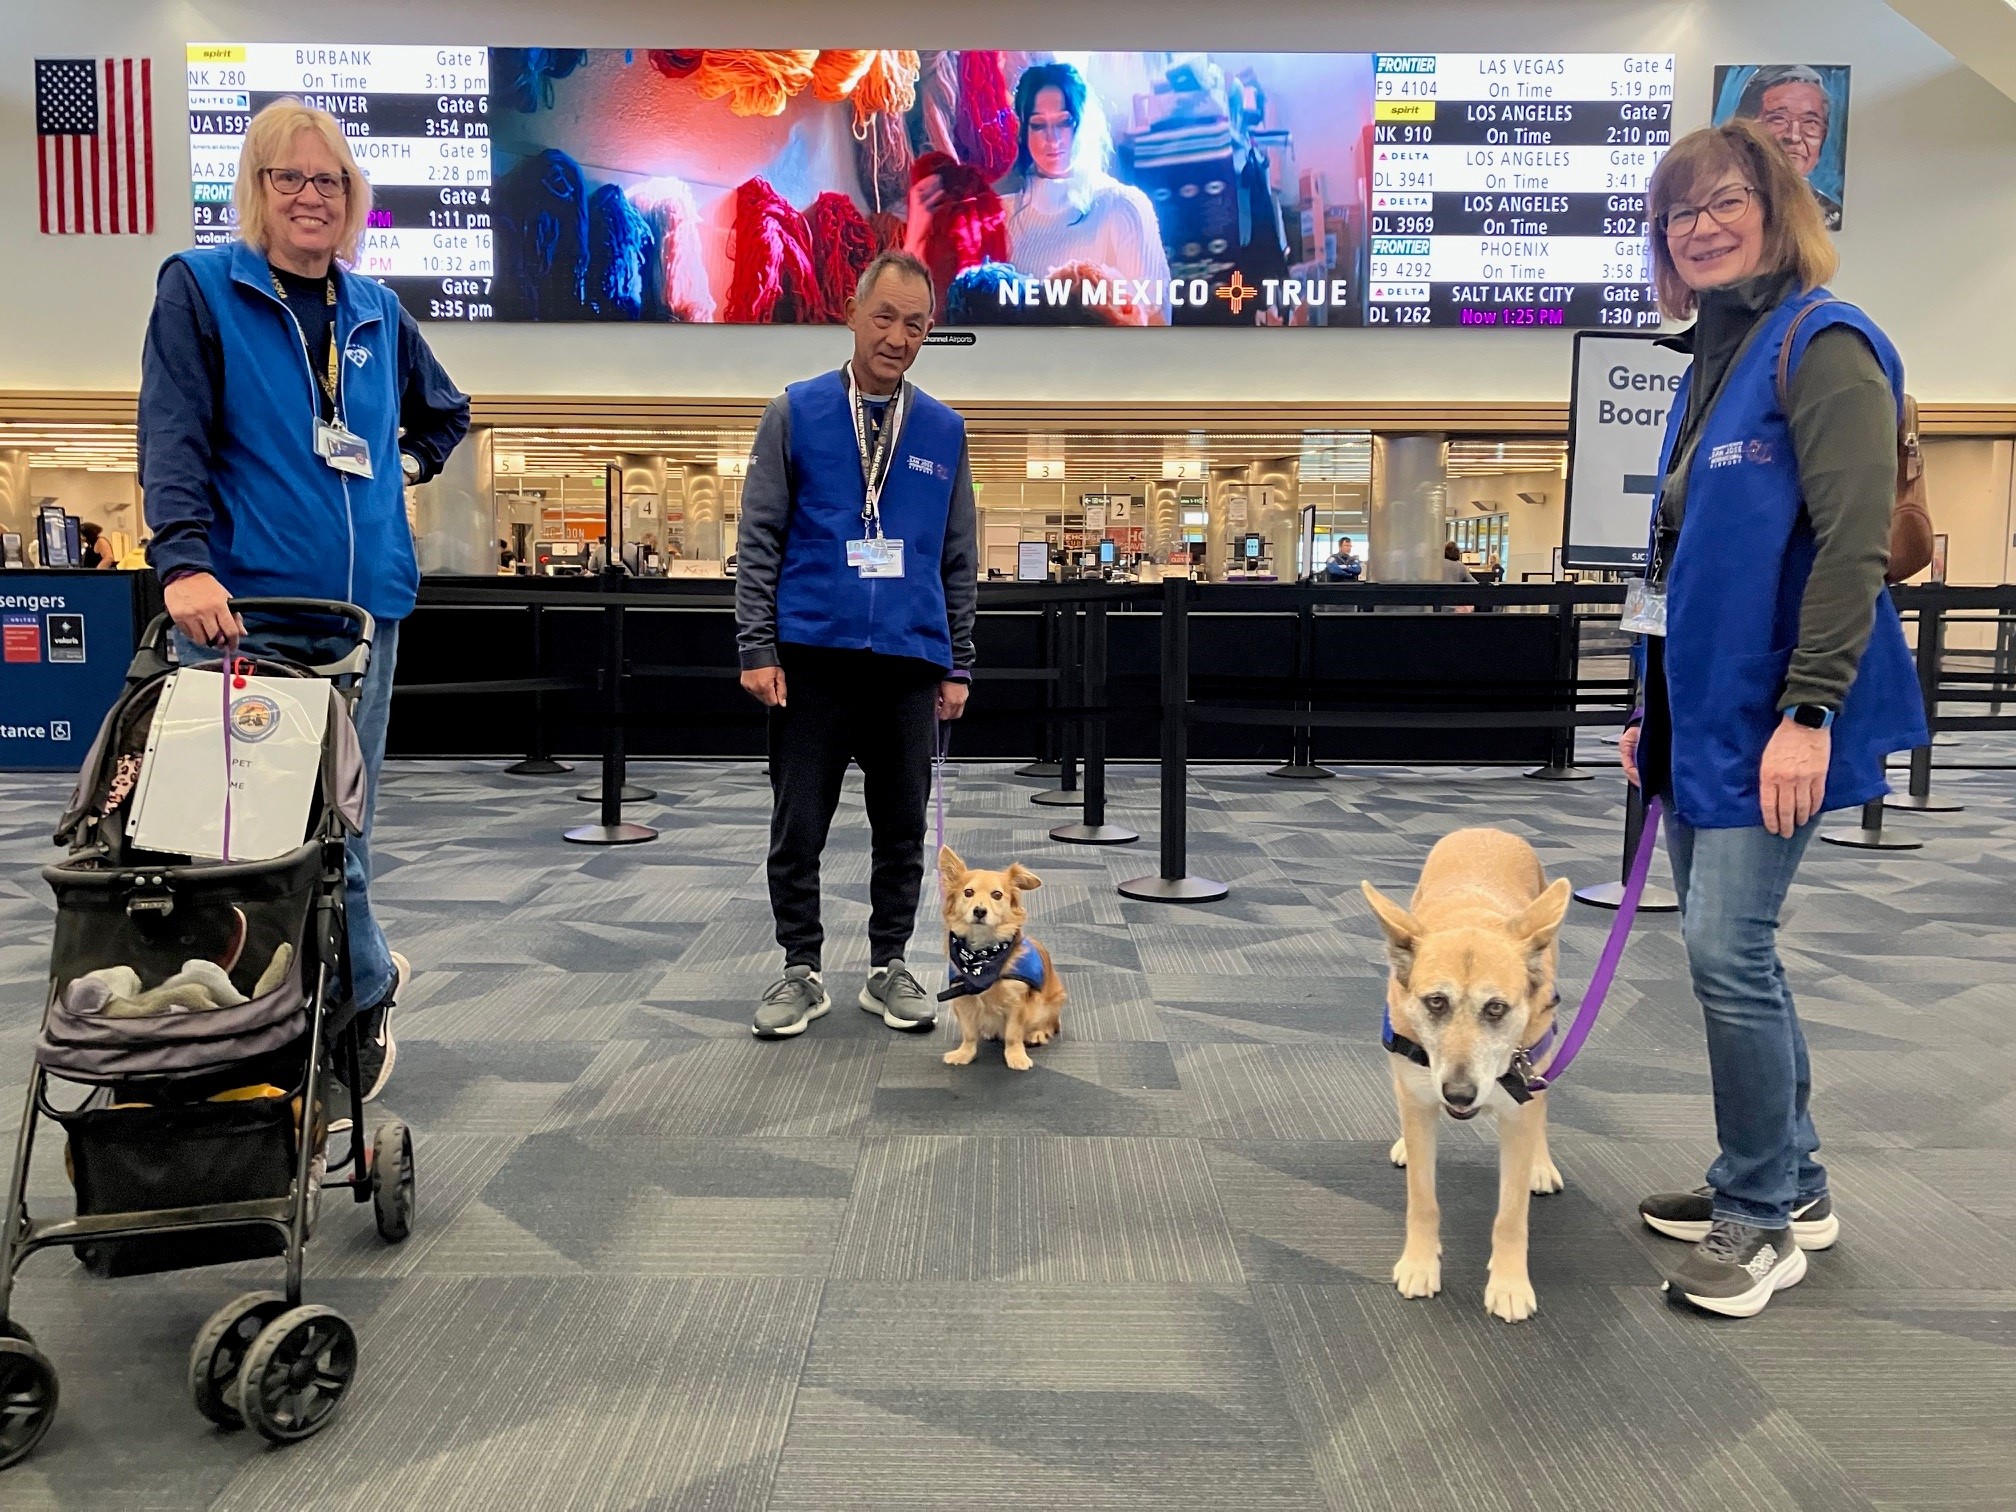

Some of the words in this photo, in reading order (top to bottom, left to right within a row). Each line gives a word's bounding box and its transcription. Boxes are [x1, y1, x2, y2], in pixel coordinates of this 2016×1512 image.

[203, 49, 231, 59] spirit
[296, 49, 371, 65] BURBANK
[437, 51, 471, 66] Gate
[478, 51, 485, 65] 7
[1377, 57, 1435, 72] FRONTIER
[1480, 60, 1506, 74] LAS
[1513, 59, 1564, 74] VEGAS
[1624, 58, 1659, 73] Gate
[1665, 58, 1673, 72] 4
[189, 71, 209, 85] NK
[220, 71, 246, 85] 280
[303, 73, 323, 88] On
[331, 73, 366, 89] Time
[425, 74, 456, 89] 3:13
[464, 77, 486, 92] pm
[1377, 81, 1392, 95] F9
[1401, 81, 1437, 95] 4104
[1489, 83, 1509, 97] On
[1517, 82, 1553, 97] Time
[1610, 81, 1642, 96] 5:19
[1649, 84, 1671, 99] pm
[304, 95, 368, 113] DENVER
[437, 96, 474, 113] Gate
[478, 96, 488, 113] 6
[1391, 106, 1419, 115] spirit
[1620, 103, 1657, 120] Gate
[1662, 103, 1671, 120] 7
[1467, 105, 1496, 121] LOS
[1501, 105, 1573, 121] ANGELES
[337, 118, 370, 136] ime
[425, 119, 459, 136] 3:54
[464, 121, 488, 139] pm
[1375, 126, 1397, 142] NK
[1404, 126, 1432, 142] 910
[1487, 128, 1508, 144] On
[1514, 127, 1551, 144] Time
[1606, 126, 1640, 143] 2:10
[1646, 130, 1670, 146] pm
[353, 144, 411, 158] WORTH
[440, 143, 474, 158] Gate
[481, 144, 488, 158] 9
[1610, 150, 1645, 165] Gate
[1467, 151, 1494, 166] LOS
[1501, 151, 1570, 166] ANGELES
[428, 166, 459, 180] 2:28
[467, 169, 489, 184] pm
[1375, 172, 1392, 187] DL
[1399, 172, 1433, 187] 3941
[1486, 174, 1505, 188] On
[1514, 174, 1548, 188] Time
[1606, 173, 1636, 188] 3:41
[194, 184, 233, 200] FRONT
[440, 188, 476, 205] Gate
[480, 188, 490, 205] 4
[1464, 196, 1493, 212] LOS
[1498, 196, 1569, 212] ANGELES
[1607, 195, 1644, 212] Gate
[194, 207, 211, 224] F9
[368, 211, 391, 227] PM
[429, 211, 460, 227] 1:11
[467, 213, 490, 229] pm
[1372, 217, 1392, 233] DL
[1397, 217, 1434, 233] 3969
[1483, 219, 1505, 234] On
[1511, 218, 1547, 234] Time
[1603, 218, 1635, 234] 5:02
[1641, 221, 1650, 237] p
[433, 234, 468, 249] Gate
[475, 235, 490, 249] 16
[1372, 240, 1429, 254] FRONTIER
[1481, 242, 1549, 256] PHOENIX
[1615, 242, 1650, 256] Gate
[370, 257, 392, 271] PM
[423, 257, 462, 271] 10:32
[469, 261, 491, 271] am
[1372, 262, 1387, 277] F9
[1396, 262, 1431, 277] 4292
[1483, 264, 1502, 279] On
[1511, 264, 1545, 279] Time
[1602, 264, 1633, 279] 3:58
[442, 278, 479, 295] Gate
[482, 279, 492, 295] 7
[998, 279, 1072, 306] NEW
[1082, 279, 1209, 306] MEXICO
[1262, 279, 1348, 306] TRUE
[1387, 288, 1424, 296] DELTA
[1452, 286, 1490, 302] SALT
[1495, 286, 1534, 302] LAKE
[1540, 286, 1575, 302] CITY
[1603, 286, 1639, 301] Gate
[430, 300, 463, 317] 3:35
[468, 303, 493, 321] pm
[1369, 307, 1389, 322] DL
[1395, 307, 1431, 322] 1262
[1462, 309, 1497, 324] Now
[1503, 309, 1534, 324] 1:25
[1540, 309, 1562, 324] PM
[1600, 308, 1631, 324] 1:30
[1636, 311, 1660, 327] pm
[1608, 365, 1682, 392] Gene
[1599, 400, 1671, 426] Boar
[502, 460, 510, 471] 5
[733, 463, 741, 474] 4
[1042, 466, 1049, 478] 3
[1178, 466, 1185, 478] 2
[643, 501, 652, 515] 4
[1116, 503, 1125, 517] 2
[562, 546, 568, 555] 5
[1631, 553, 1645, 561] SJC
[232, 758, 253, 768] PET
[230, 781, 245, 790] ME
